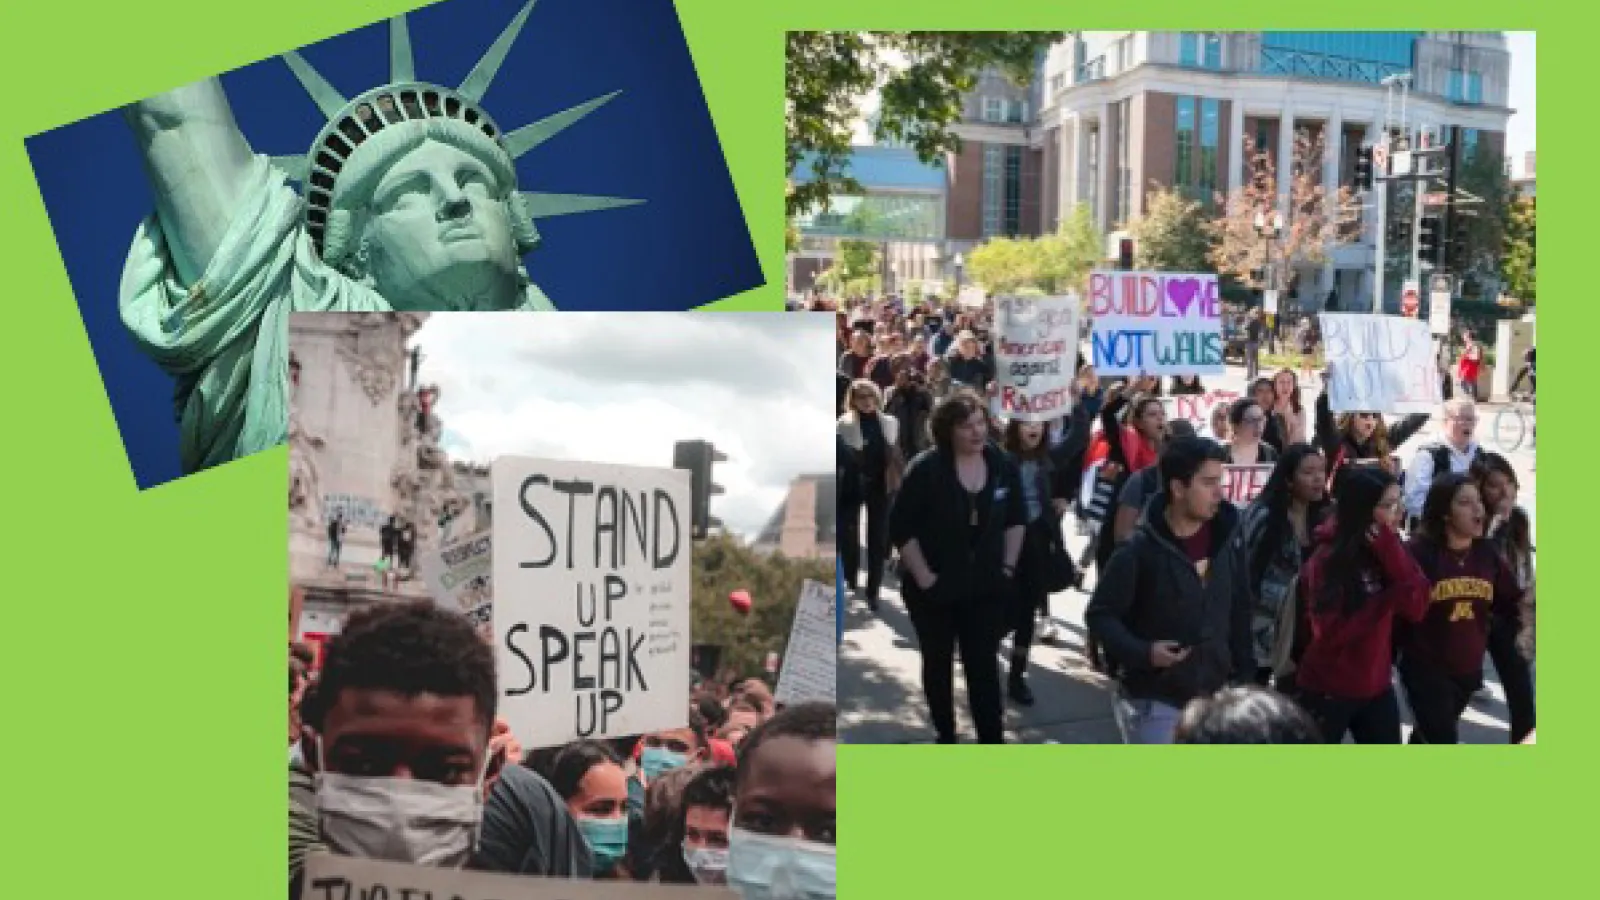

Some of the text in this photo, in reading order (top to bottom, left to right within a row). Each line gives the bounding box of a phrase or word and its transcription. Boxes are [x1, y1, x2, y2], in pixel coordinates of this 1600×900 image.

[1090, 273, 1158, 317] BUILD
[1092, 329, 1151, 368] NOT
[517, 473, 681, 570] STAND
[576, 575, 629, 628] UP
[504, 621, 650, 697] SPEAK
[575, 690, 625, 738] UP
